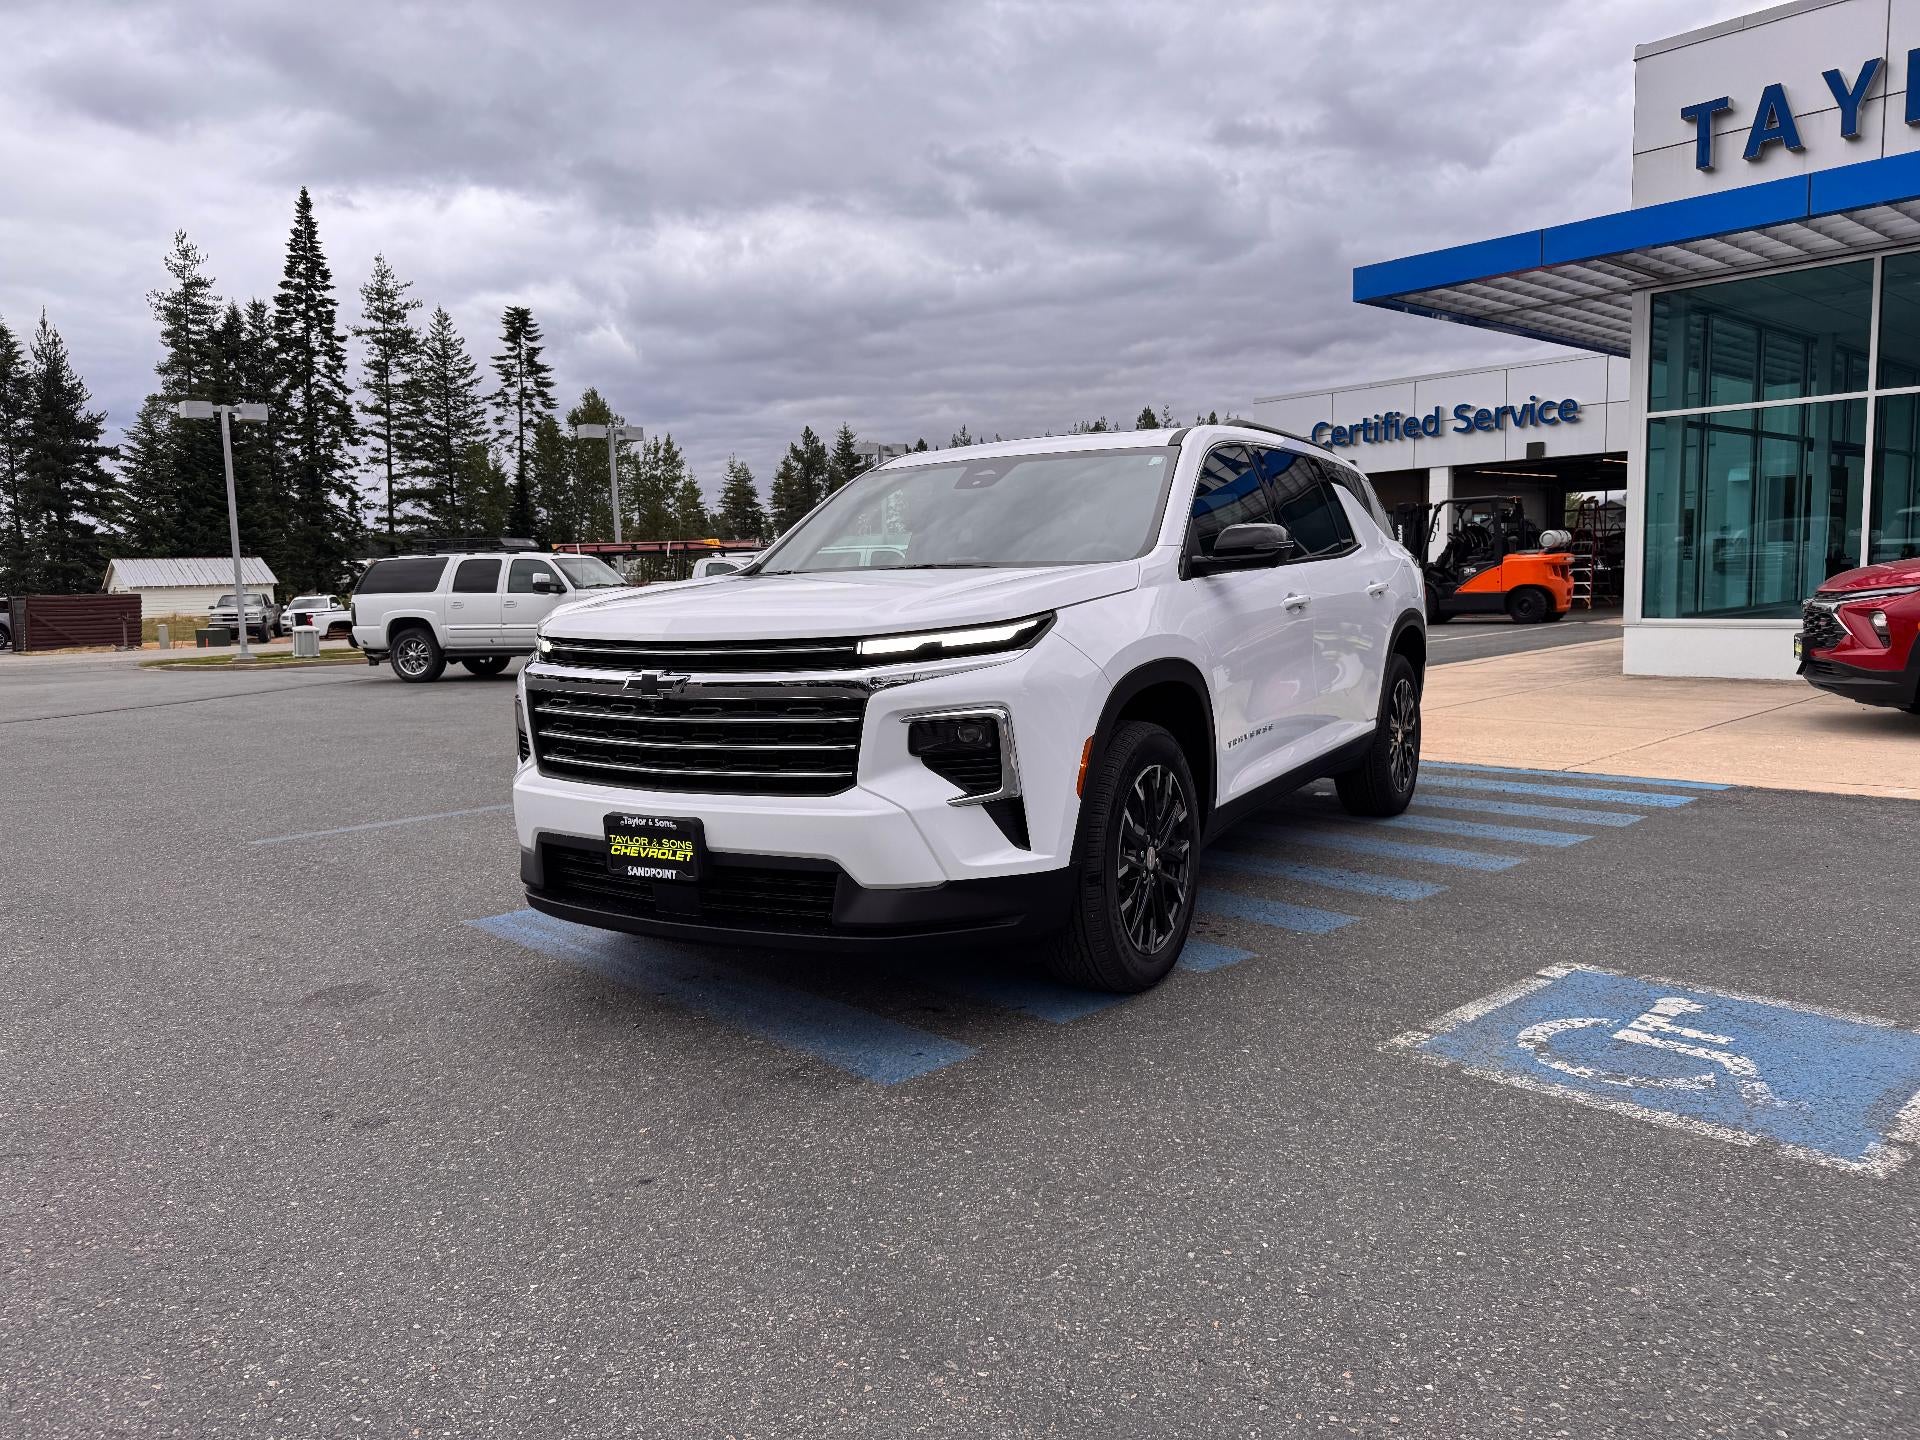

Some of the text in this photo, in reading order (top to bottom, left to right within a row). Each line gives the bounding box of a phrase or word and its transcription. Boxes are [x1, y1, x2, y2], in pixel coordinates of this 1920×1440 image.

[1311, 395, 1580, 447] Certified Service
[1227, 724, 1274, 748] TRAVERSE
[623, 816, 646, 827] Taylor
[655, 818, 673, 828] Sons
[609, 835, 693, 850] TAYLOR & SONS
[611, 845, 693, 861] CHEVROLET
[627, 866, 677, 879] SANDPOINT
